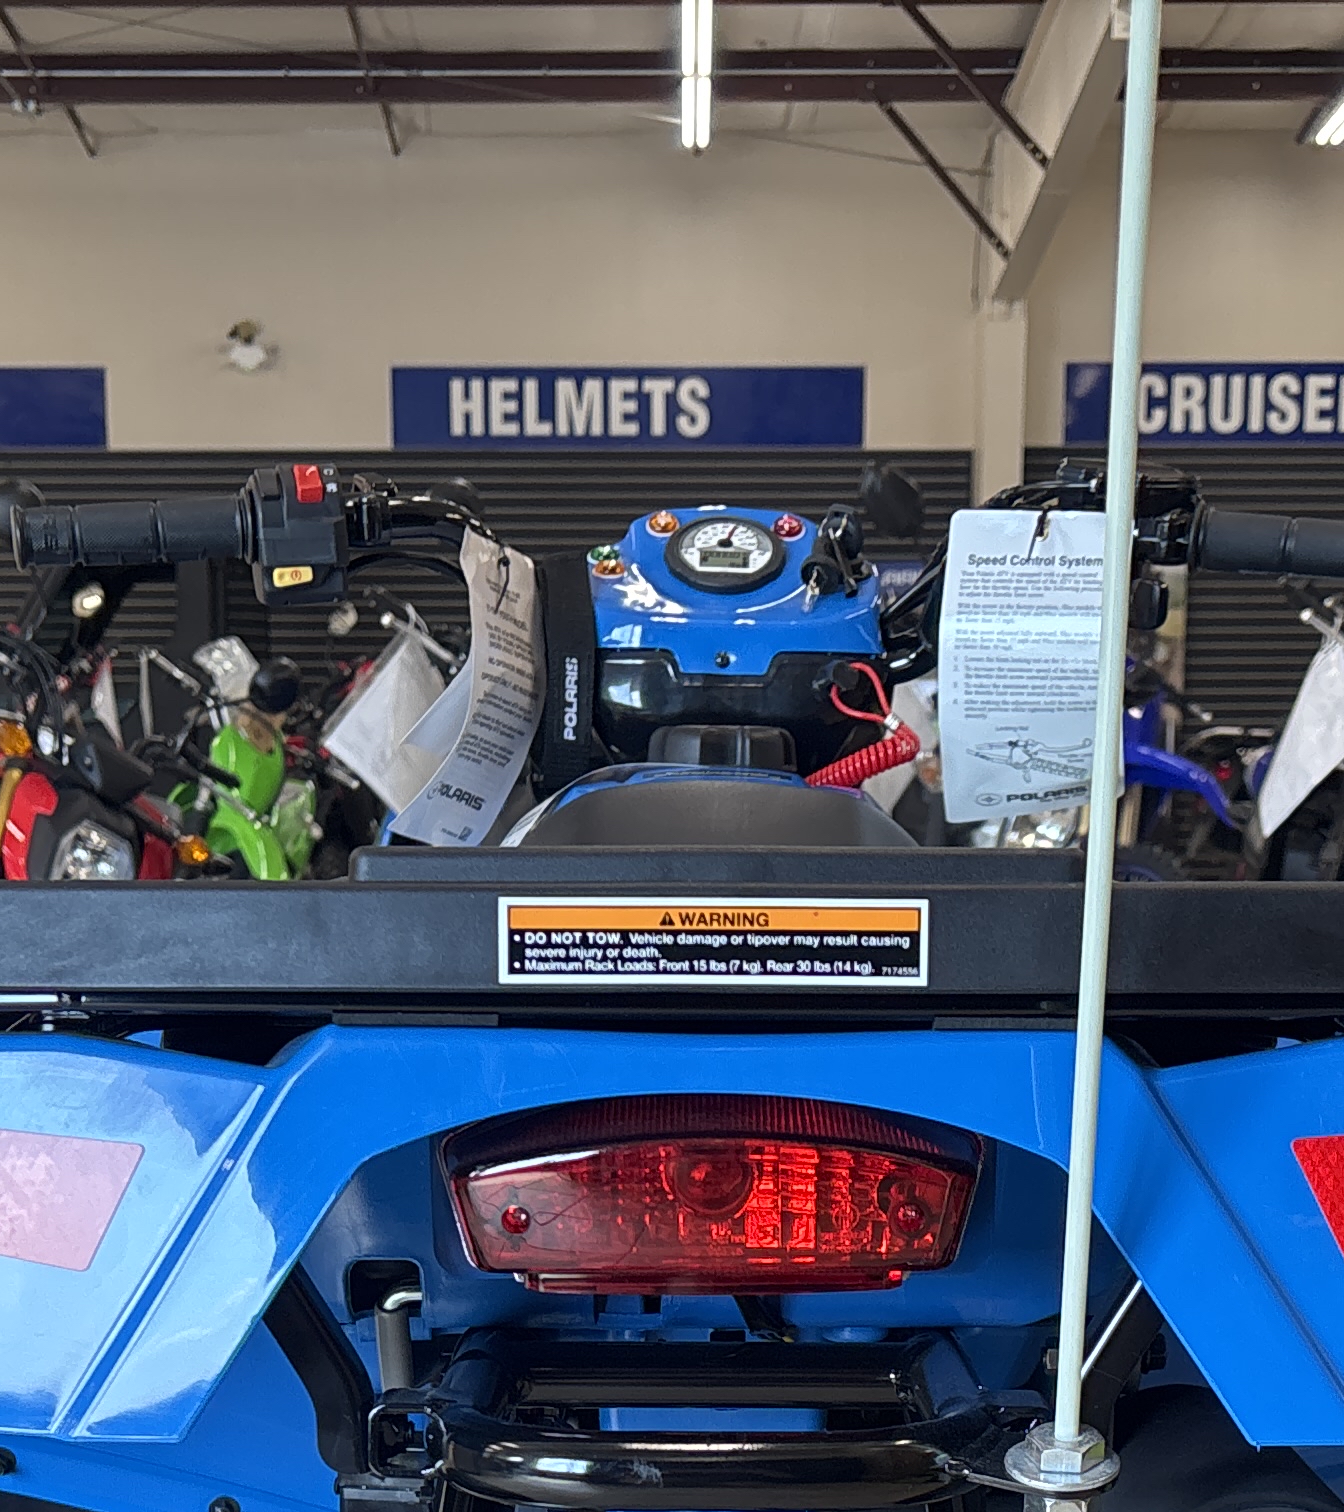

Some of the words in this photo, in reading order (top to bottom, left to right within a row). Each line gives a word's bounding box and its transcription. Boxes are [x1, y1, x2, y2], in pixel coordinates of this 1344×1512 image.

[449, 376, 711, 438] HELMETS
[968, 554, 1007, 568] Speed
[1010, 555, 1055, 566] Control
[1058, 555, 1104, 567] System
[563, 656, 579, 741] POLARIS
[437, 780, 486, 811] POLARIS
[1006, 786, 1088, 803] POLARIS
[678, 911, 770, 927] WARNING
[524, 932, 547, 945] DO
[551, 932, 582, 945] NOT
[586, 932, 624, 945] TOW.
[629, 932, 674, 945] Vehicle
[677, 932, 727, 948] damage
[730, 936, 745, 946] or
[747, 933, 791, 948] tipover
[793, 936, 821, 949] may
[823, 934, 858, 946] result
[861, 935, 910, 949] causing
[525, 949, 566, 958] severe
[569, 947, 603, 960] injury
[606, 949, 620, 958] or
[623, 947, 662, 958] death.
[524, 959, 583, 971] Maximum
[585, 960, 614, 971] Rack
[617, 960, 656, 972] Loads:
[659, 960, 689, 972] Front
[692, 960, 707, 972] 15
[709, 960, 727, 972] lbs
[729, 960, 741, 974] (7
[743, 960, 764, 974] kg).
[767, 960, 795, 973] Rear
[796, 960, 811, 973] 30
[814, 960, 831, 973] lbs
[833, 960, 851, 975] (14
[853, 961, 875, 976] kg).
